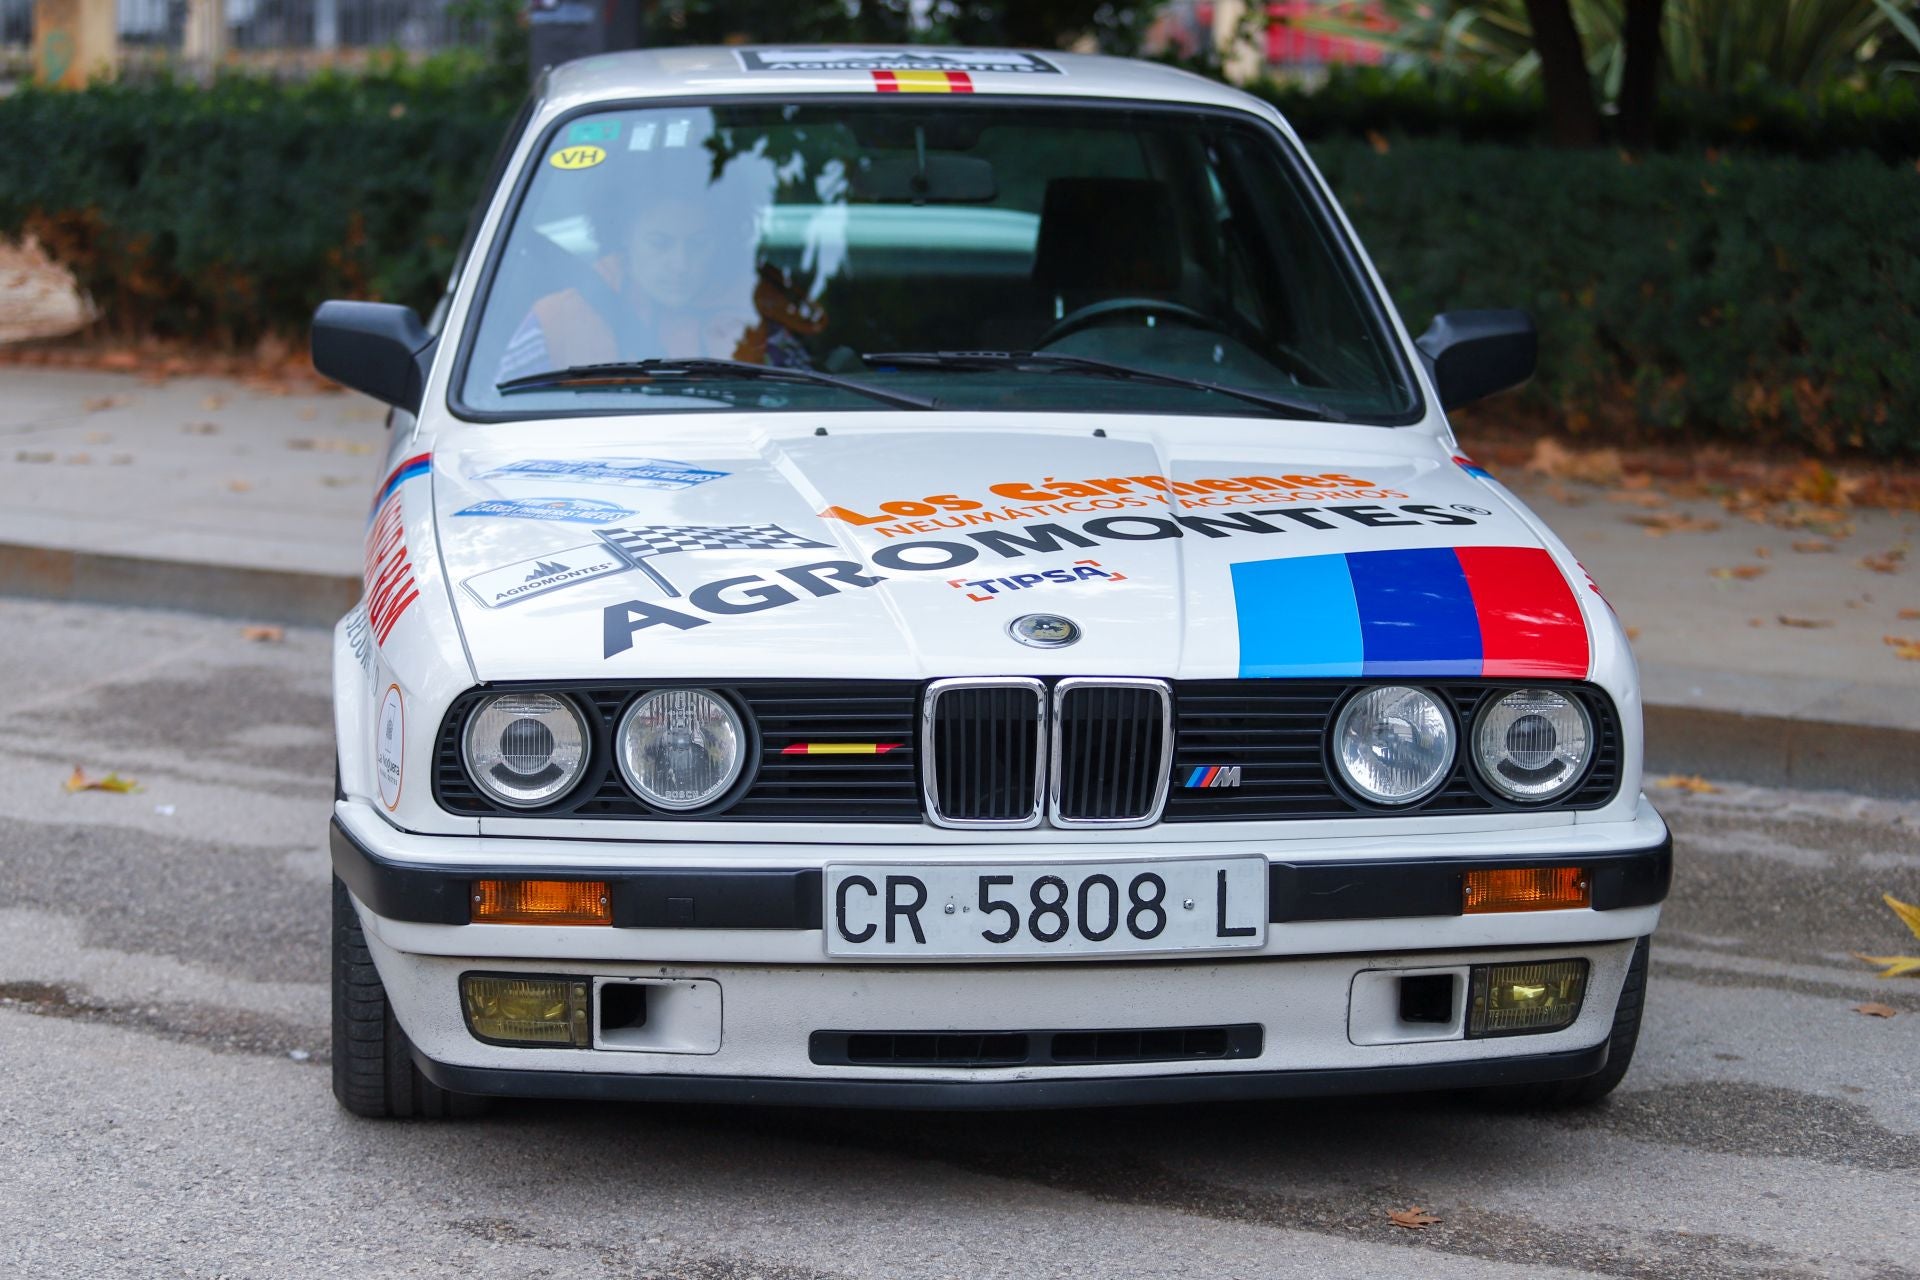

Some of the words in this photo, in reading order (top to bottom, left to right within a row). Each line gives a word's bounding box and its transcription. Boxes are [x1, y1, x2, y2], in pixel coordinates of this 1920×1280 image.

[561, 151, 597, 164] VH
[873, 496, 1148, 538] NEUMÁTICOS
[965, 566, 1113, 594] TIPSA
[835, 875, 928, 944] CR
[978, 872, 1167, 943] 5808
[1216, 869, 1257, 938] L
